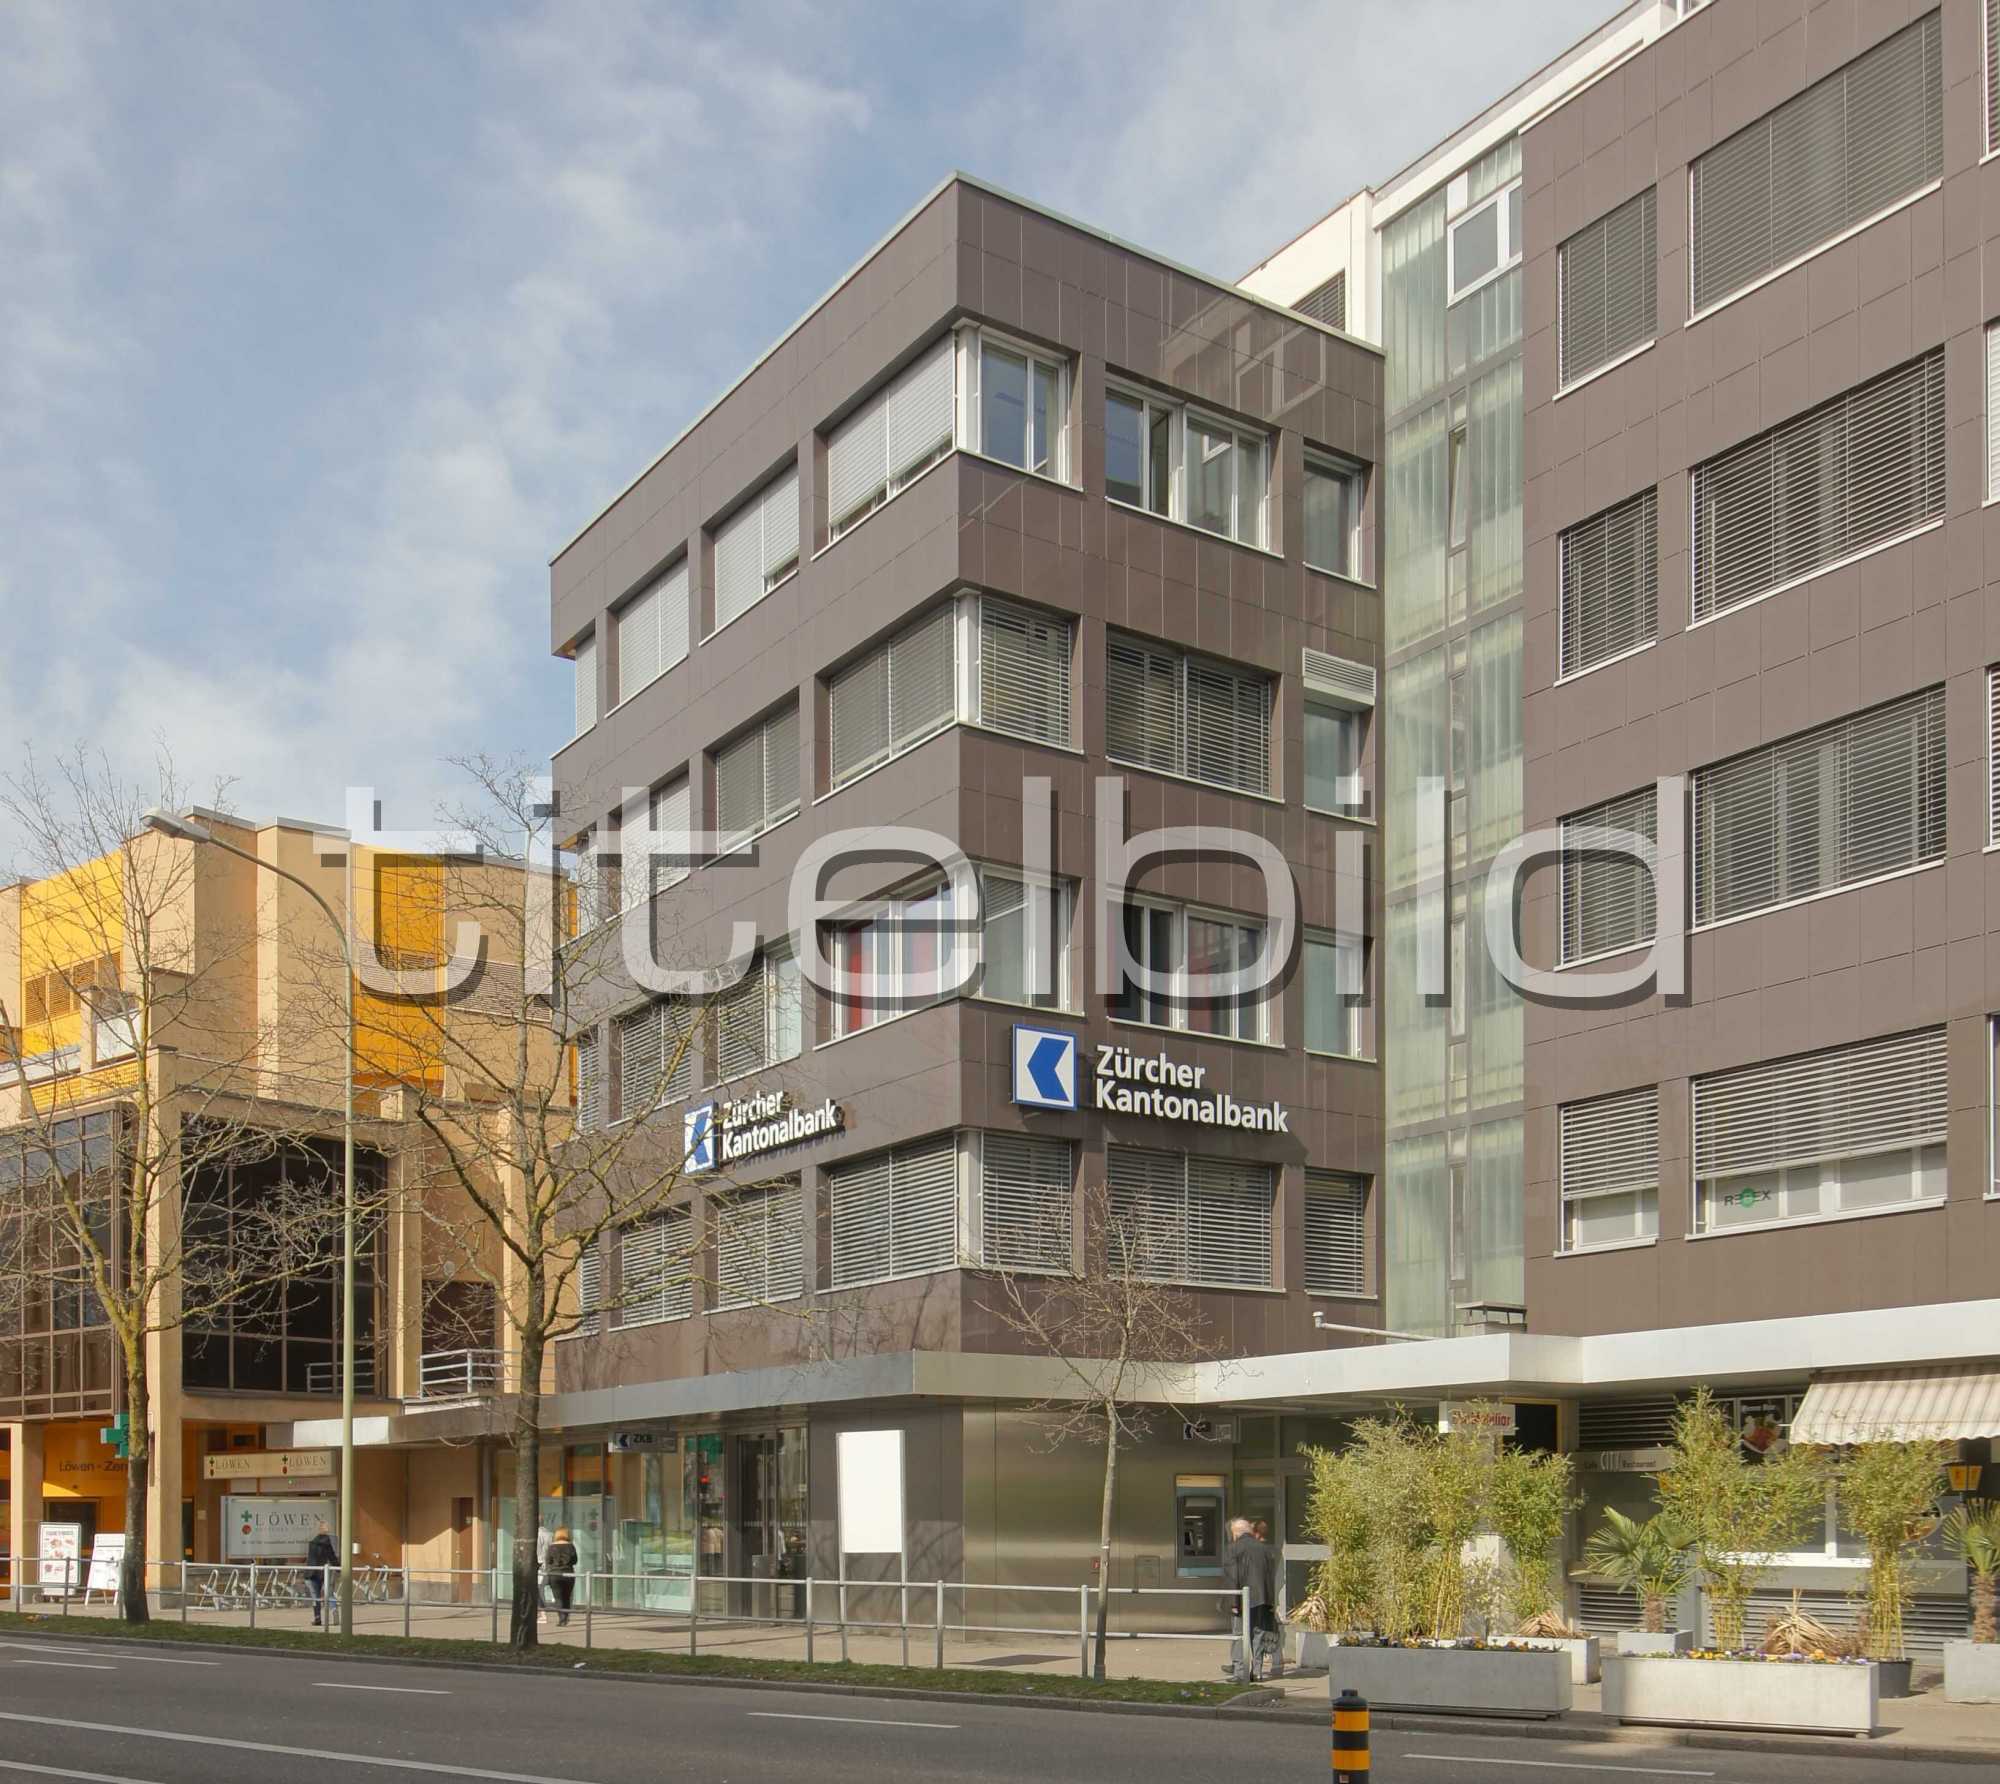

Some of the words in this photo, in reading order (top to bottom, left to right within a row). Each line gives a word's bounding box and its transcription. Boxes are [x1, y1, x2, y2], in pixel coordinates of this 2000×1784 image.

[1097, 1045, 1205, 1089] Zürcher
[722, 1090, 784, 1129] Zürcher
[722, 1098, 837, 1160] Kantonalbank
[1096, 1079, 1288, 1132] Kantonalbank
